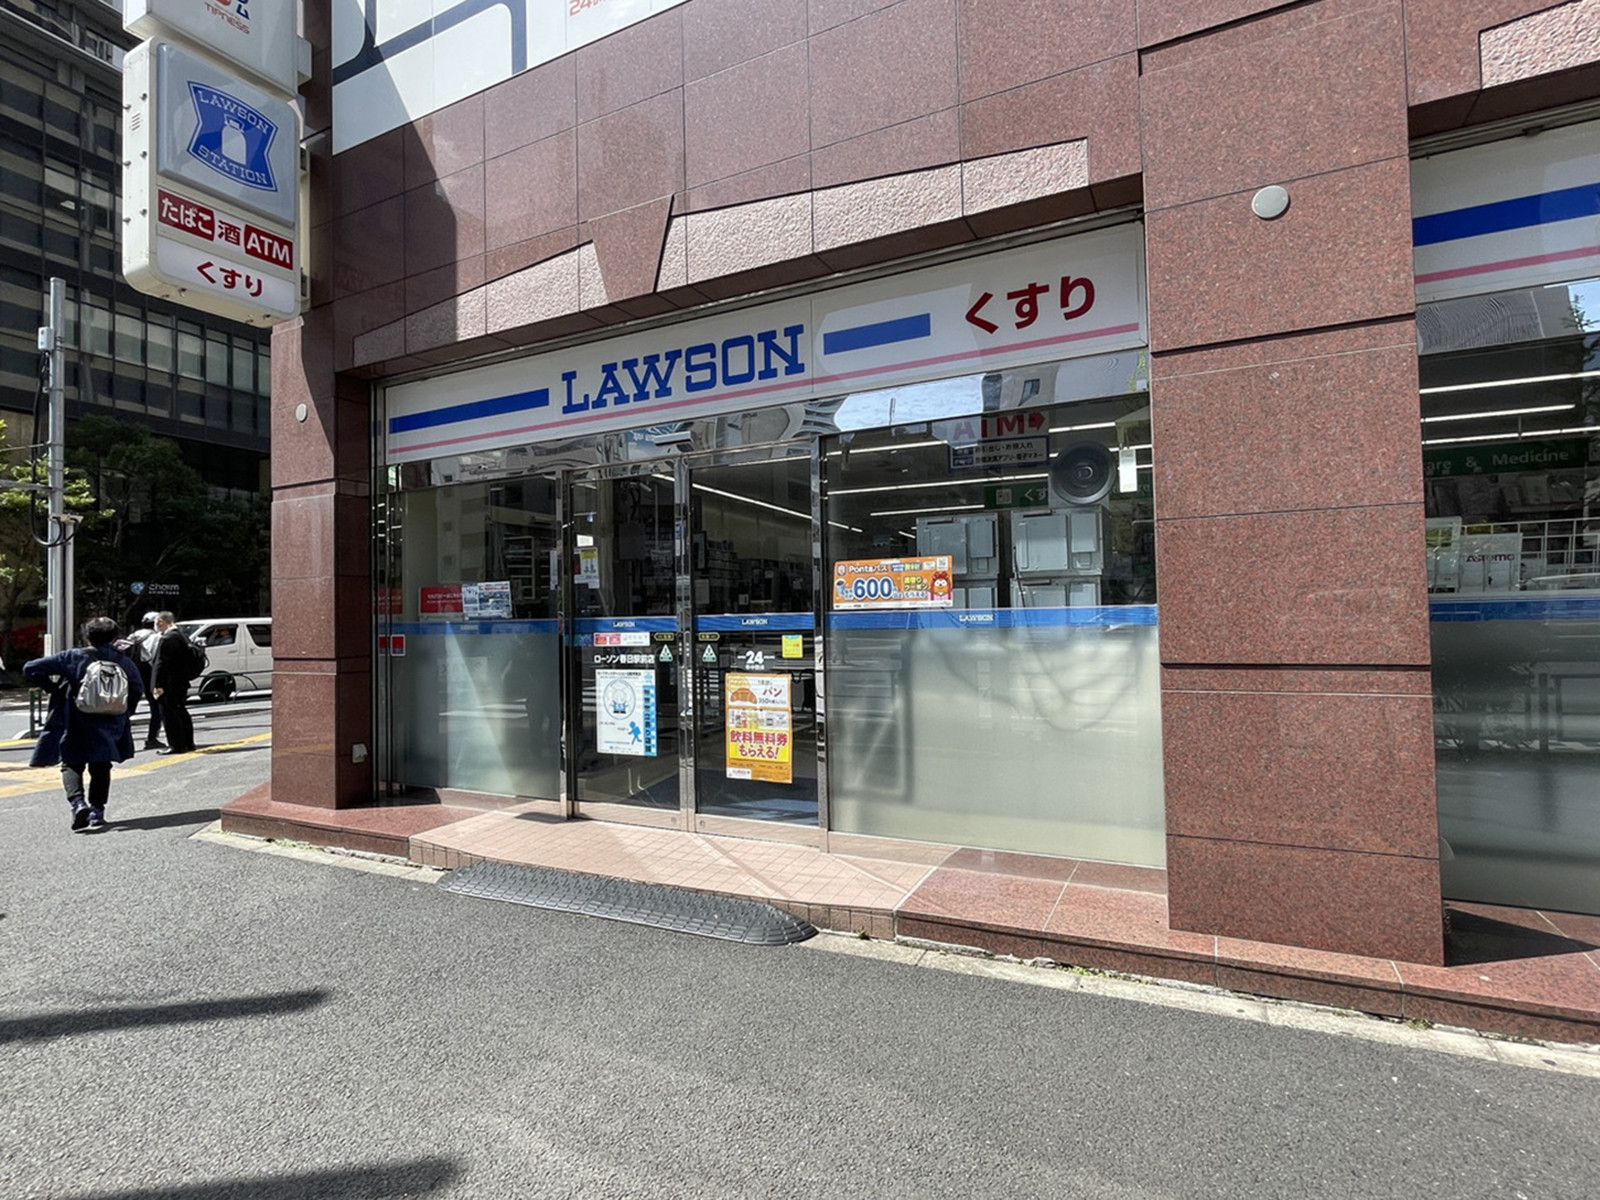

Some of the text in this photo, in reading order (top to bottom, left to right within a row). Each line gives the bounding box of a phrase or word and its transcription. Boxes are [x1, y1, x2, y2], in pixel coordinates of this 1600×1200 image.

[204, 1, 250, 34] TIPNESS
[197, 90, 269, 134] LAWSON
[197, 144, 268, 184] STATION
[161, 197, 291, 264] たばこ 酒 ATM
[196, 261, 263, 297] くすり
[965, 275, 1096, 334] くすり
[561, 324, 805, 414] LAWSON
[1492, 448, 1569, 466] Medicine
[853, 577, 891, 600] 600
[745, 650, 765, 664] 24
[762, 686, 783, 698] パン
[730, 730, 788, 746] 飲料無料券
